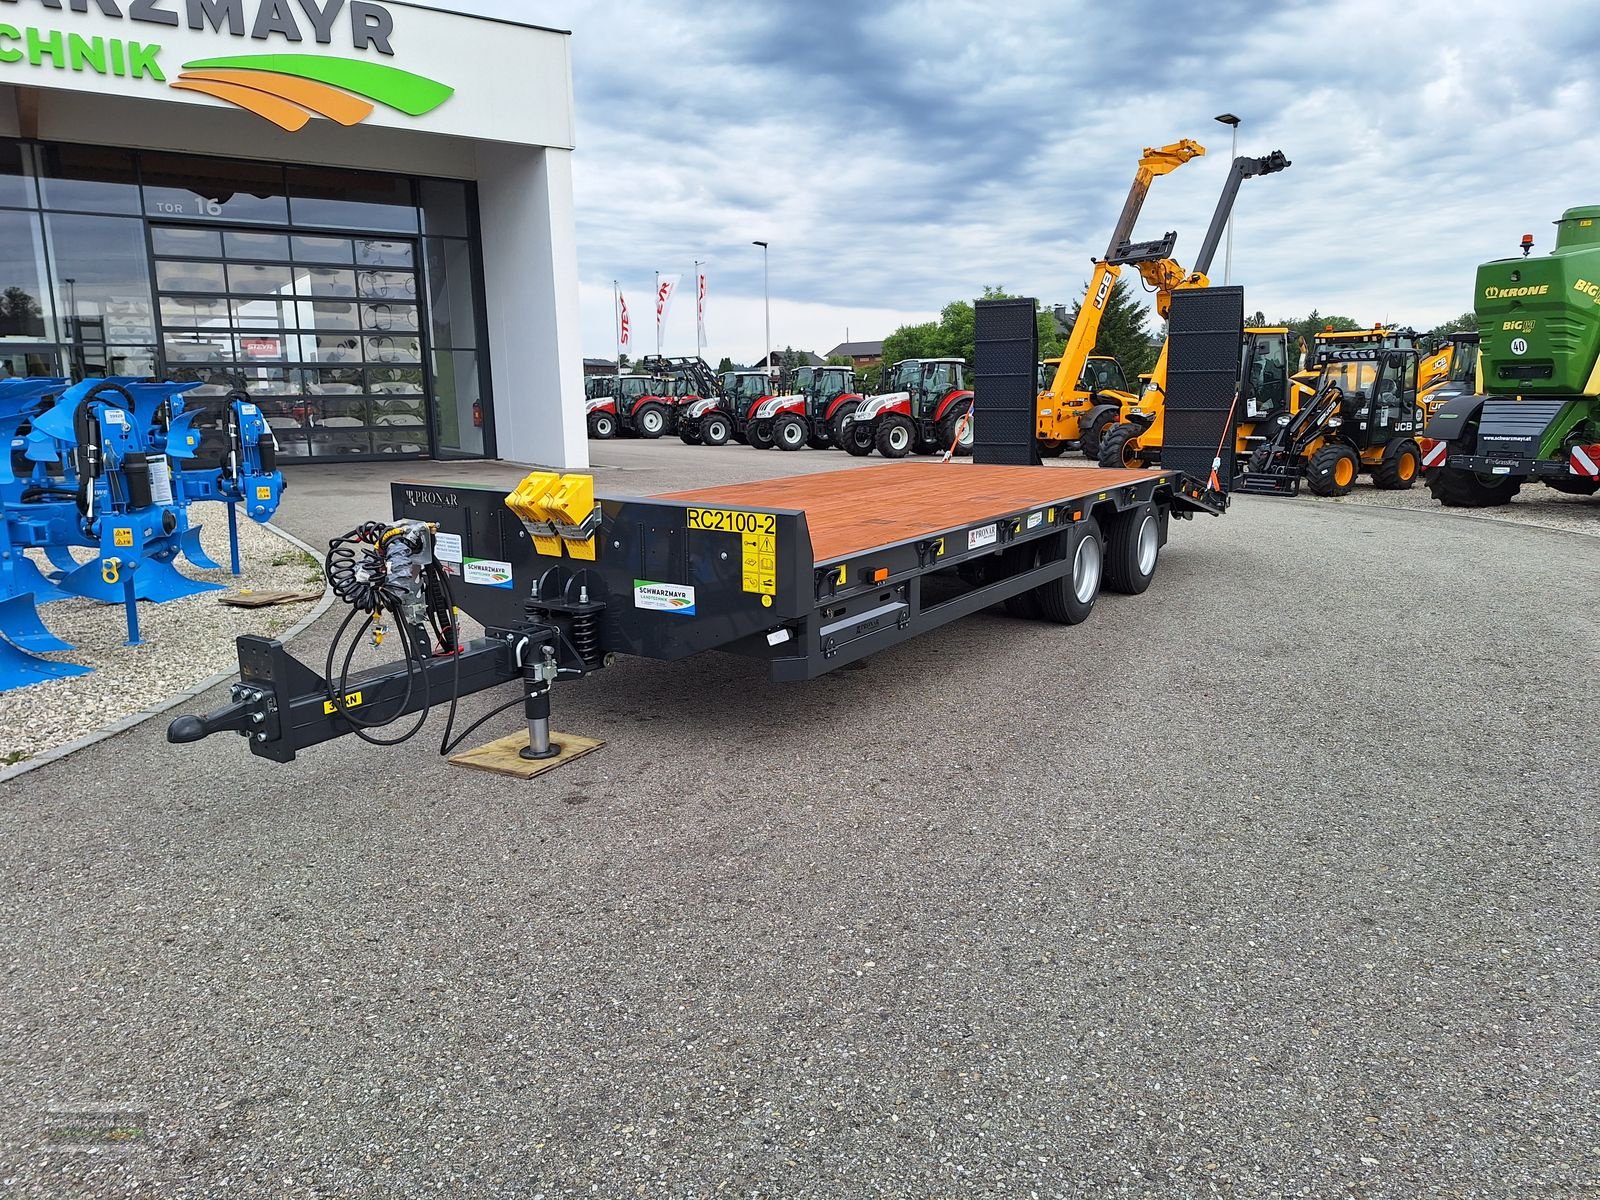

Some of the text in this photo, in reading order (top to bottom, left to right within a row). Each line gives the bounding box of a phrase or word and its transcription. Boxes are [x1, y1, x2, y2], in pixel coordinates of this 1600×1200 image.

[156, 197, 222, 216] TOR 16
[1093, 270, 1112, 310] JCB
[1499, 285, 1549, 298] KRONE
[1573, 278, 1599, 297] BiG
[1502, 320, 1523, 330] BiG
[248, 343, 273, 351] STEYR
[1513, 340, 1525, 352] 40
[1433, 356, 1447, 370] JCB
[1395, 422, 1413, 431] JCB
[415, 490, 458, 506] PRONAR
[687, 509, 775, 535] RC2100-2
[975, 525, 996, 540] PRONAR
[467, 563, 506, 573] SCHWARZMAYR
[639, 586, 687, 599] SCHWARZMAYR
